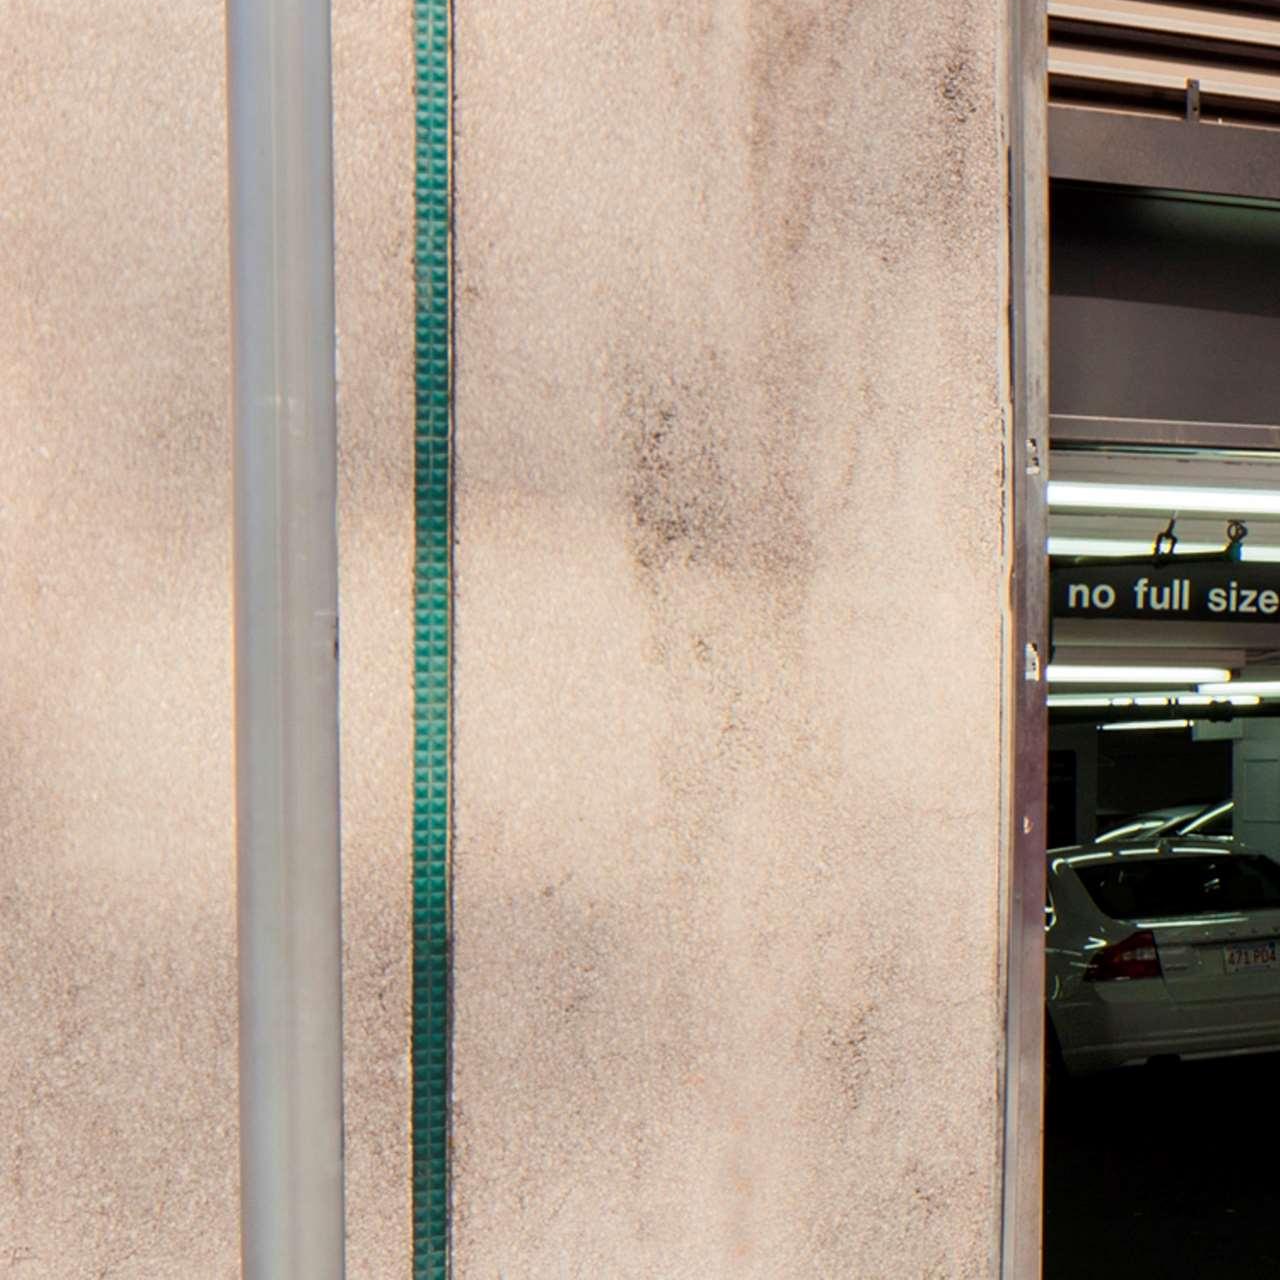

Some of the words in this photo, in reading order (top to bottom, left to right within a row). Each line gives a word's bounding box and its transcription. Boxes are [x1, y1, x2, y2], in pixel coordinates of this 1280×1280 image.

[1068, 583, 1116, 609] no
[1133, 578, 1190, 611] full
[1207, 581, 1280, 614] size
